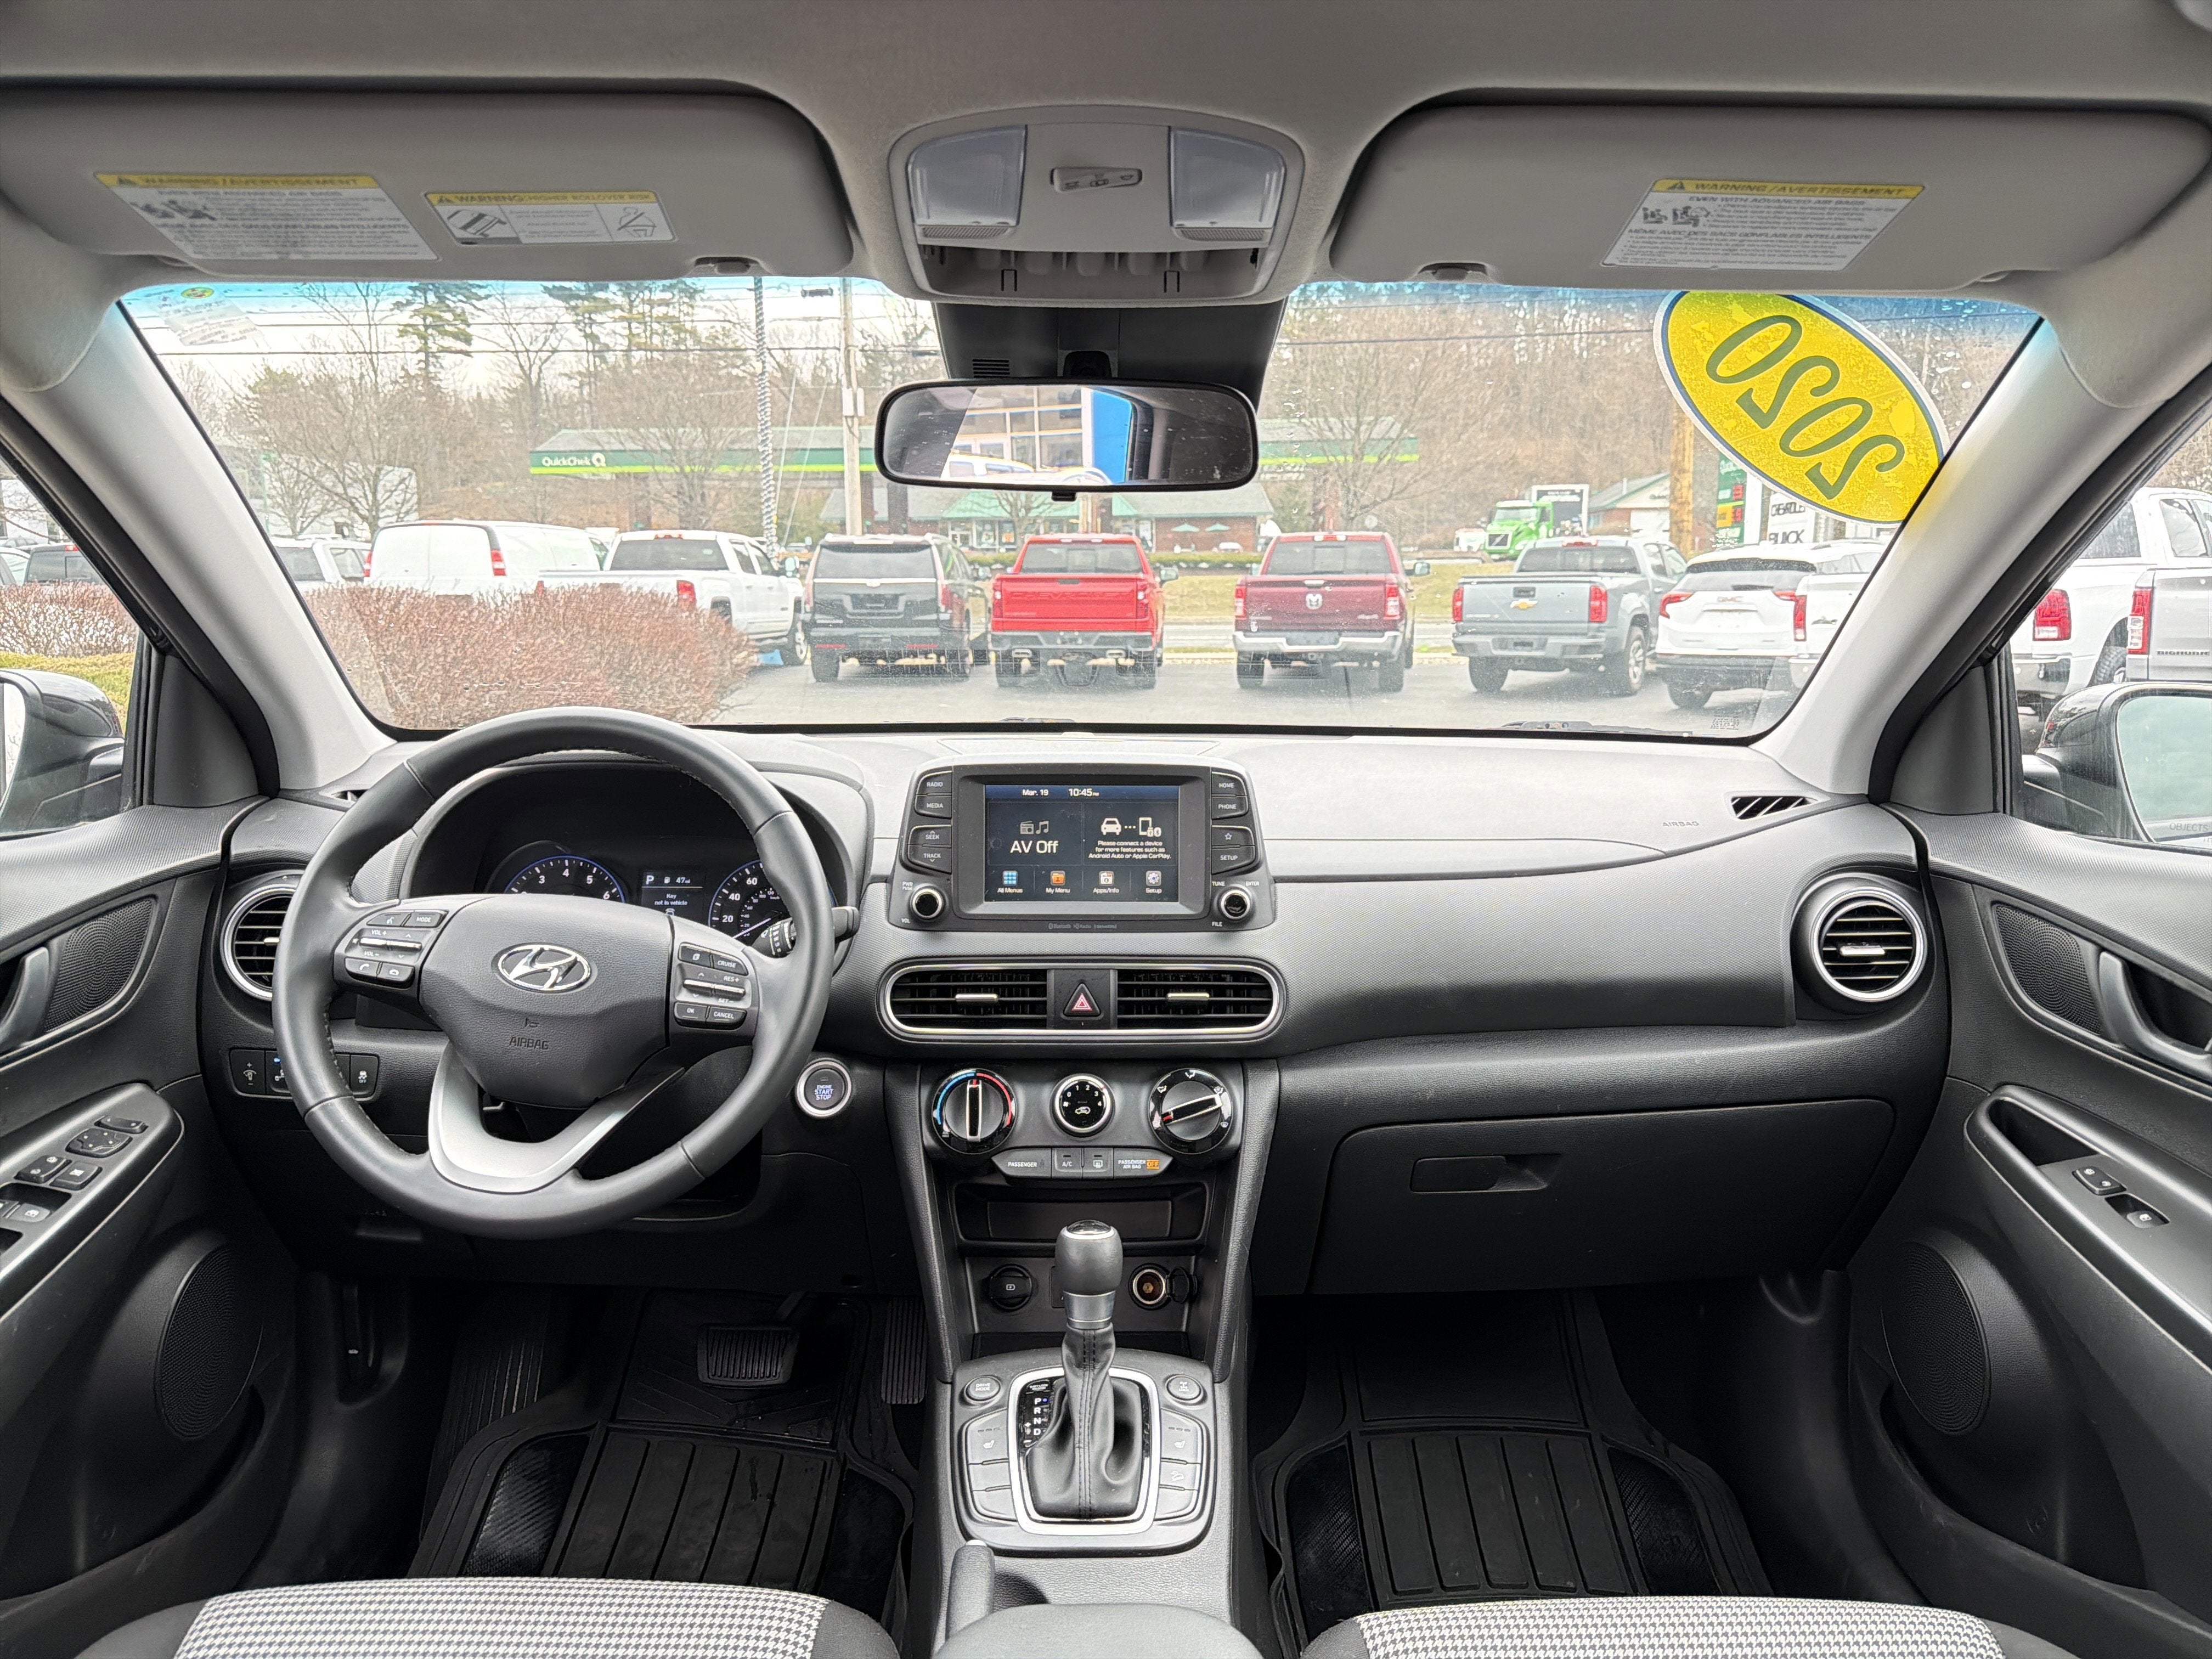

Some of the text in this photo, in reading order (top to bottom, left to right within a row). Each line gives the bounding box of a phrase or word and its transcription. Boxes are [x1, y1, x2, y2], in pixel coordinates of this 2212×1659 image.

[1695, 183, 1766, 191] WARNING
[1769, 529, 1805, 545] BUICK
[2169, 822, 2209, 832] OBJECTS
[1009, 840, 1059, 854] AV Off
[562, 868, 569, 877] 4
[538, 875, 545, 884] 3
[586, 875, 593, 884] 5
[646, 874, 654, 885] P
[746, 877, 758, 885] 60
[603, 891, 610, 900] 6
[713, 1011, 735, 1019] CANCEL
[509, 1036, 549, 1050] AIRBAG
